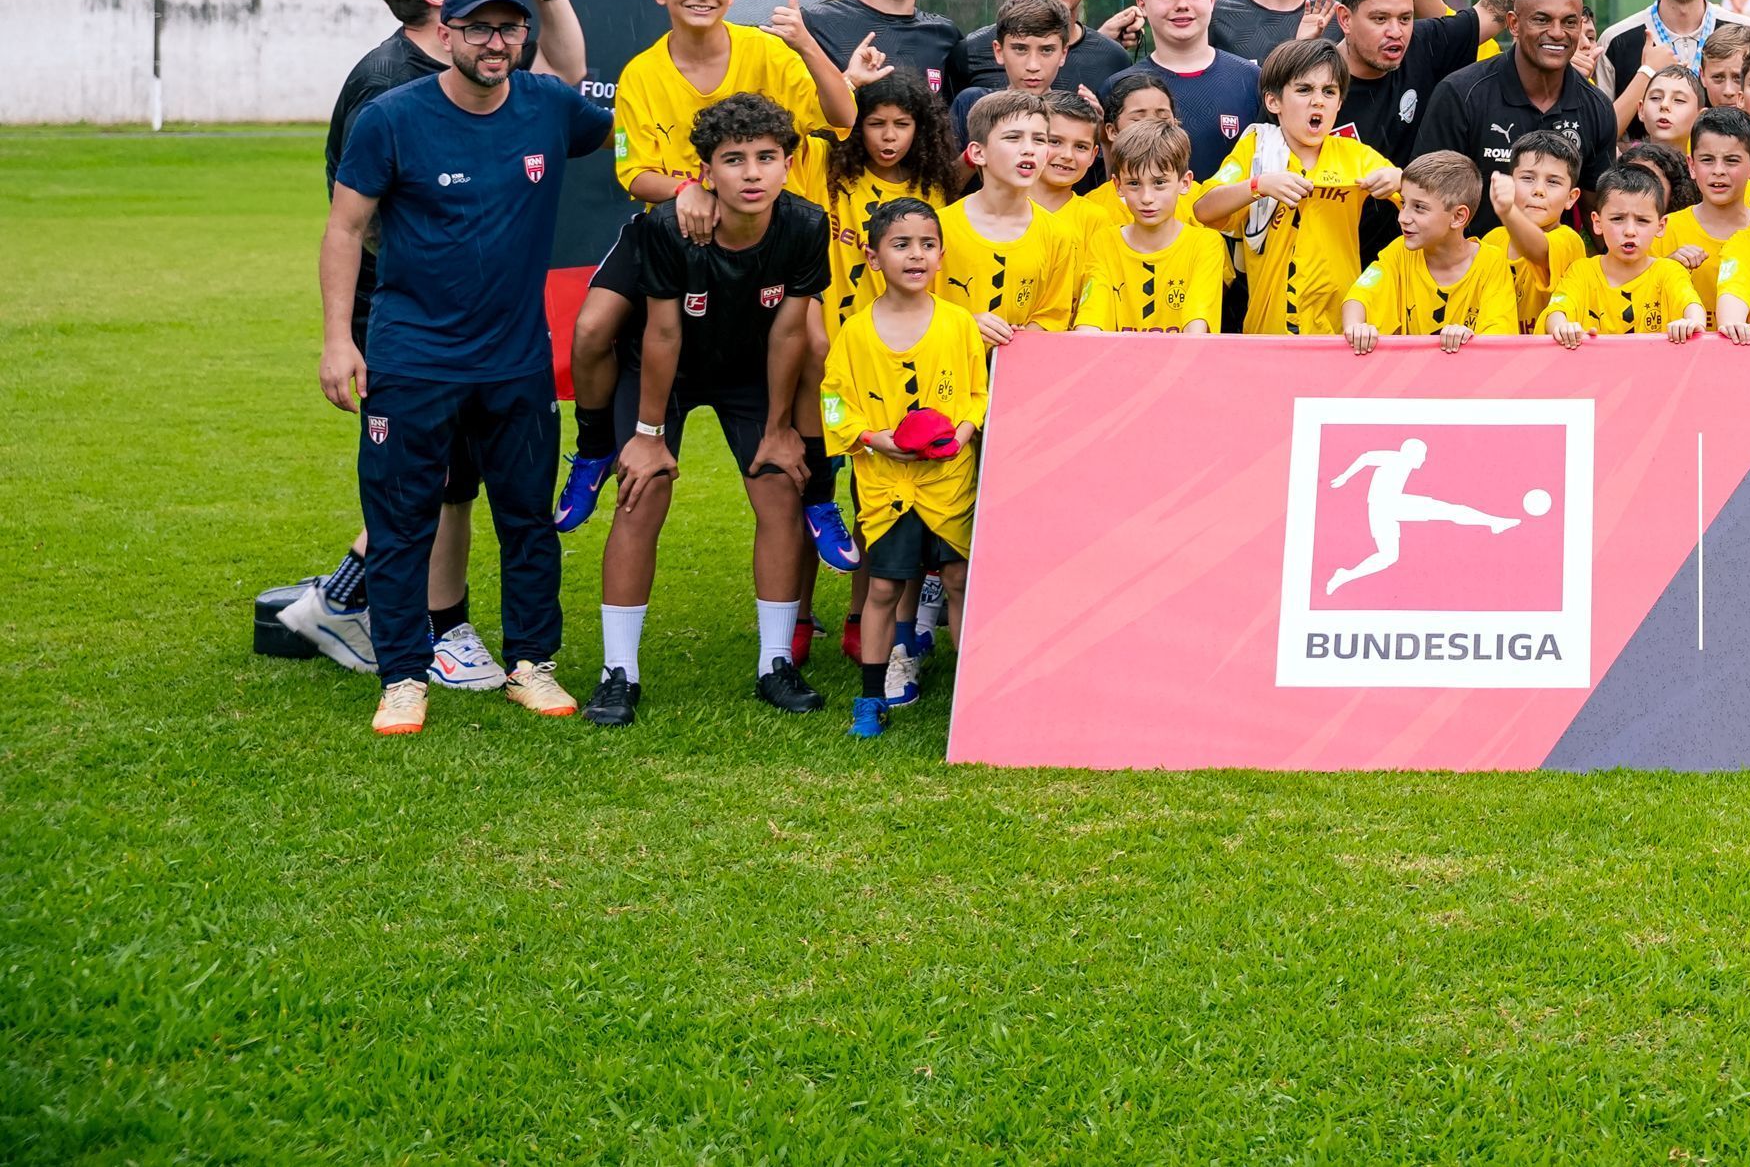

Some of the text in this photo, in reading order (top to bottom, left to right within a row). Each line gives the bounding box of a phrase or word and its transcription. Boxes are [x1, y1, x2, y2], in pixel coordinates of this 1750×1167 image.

[1222, 116, 1237, 125] KNN
[527, 156, 543, 166] KNN
[764, 286, 782, 297] KNN
[1168, 288, 1185, 304] BVB
[1646, 310, 1662, 327] BVB
[938, 381, 953, 395] BVB
[369, 418, 386, 427] KNN
[1305, 632, 1563, 661] BUNDESLIGA
